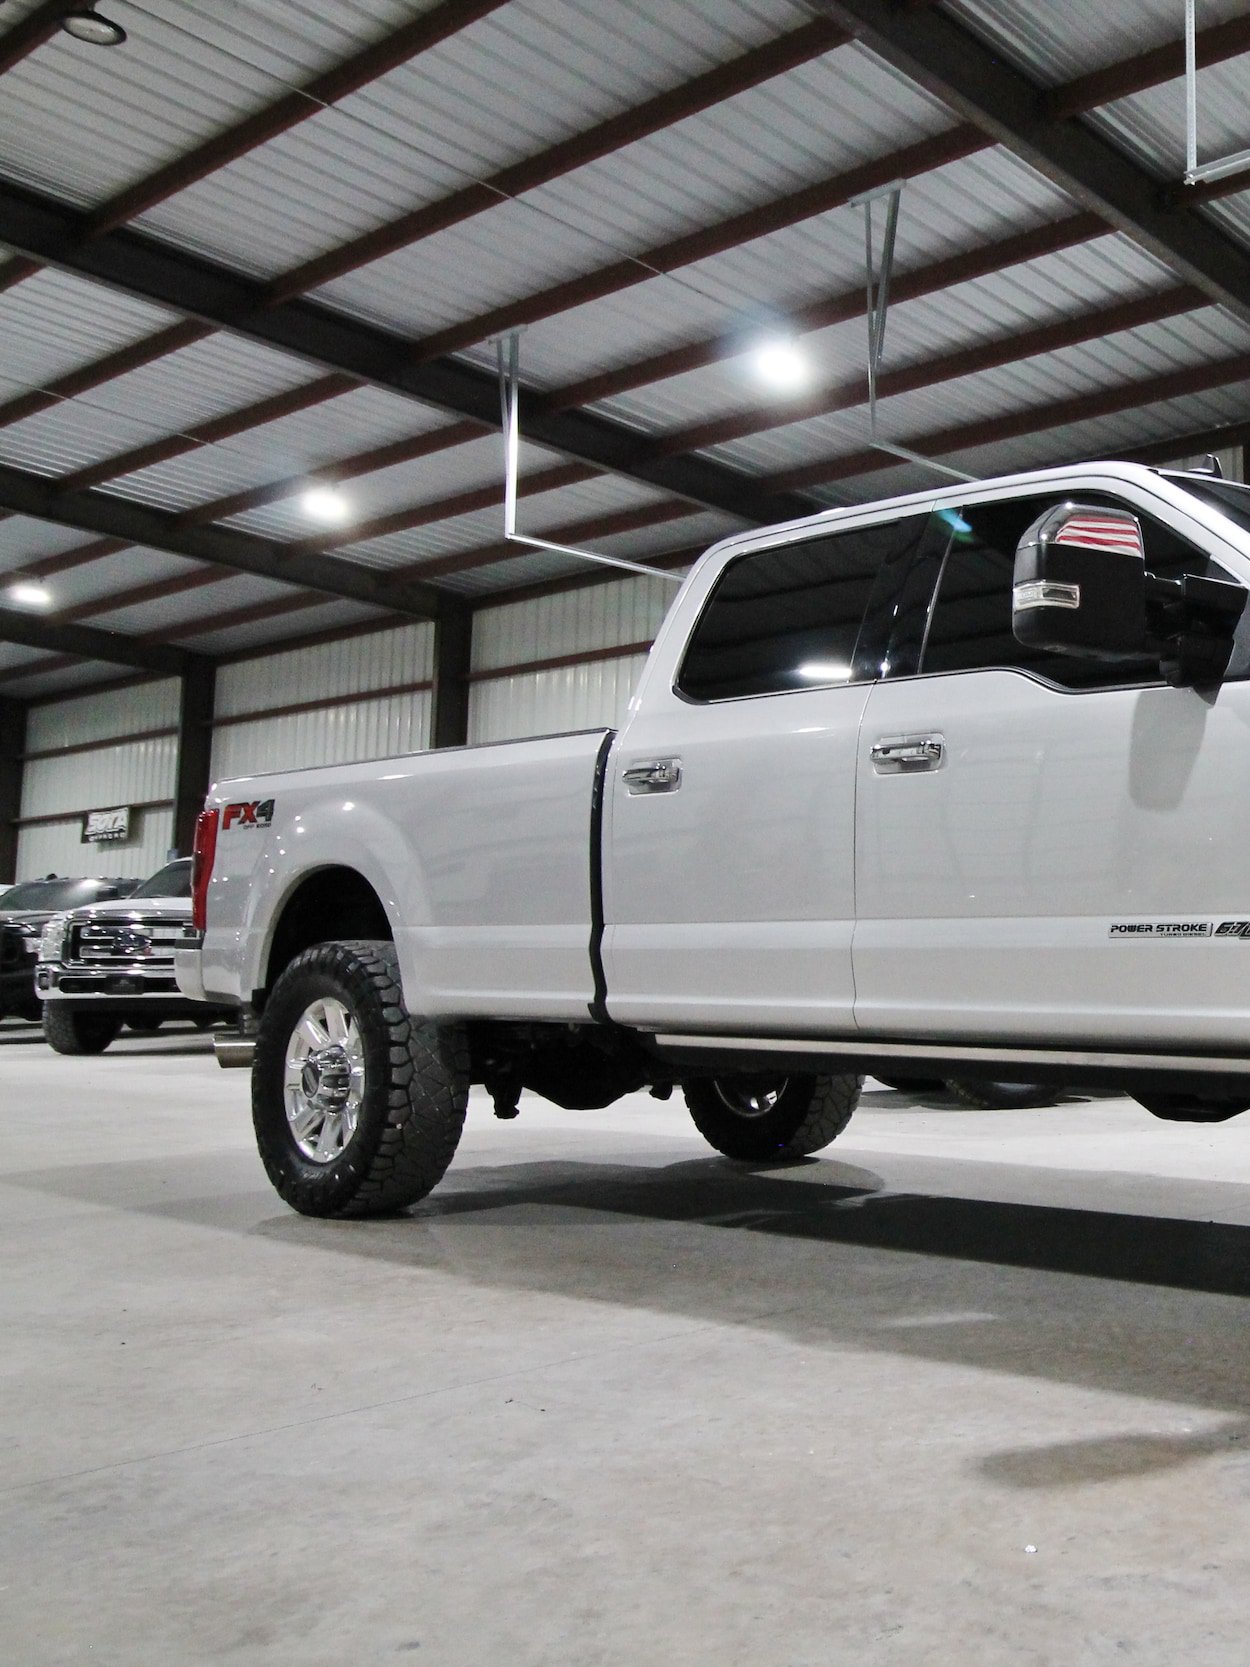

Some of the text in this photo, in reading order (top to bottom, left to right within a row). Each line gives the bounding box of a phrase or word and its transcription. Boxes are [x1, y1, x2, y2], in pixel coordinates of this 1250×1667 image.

[222, 799, 275, 830] FX4
[1110, 924, 1153, 933] POWER
[1156, 923, 1207, 932] STROKE
